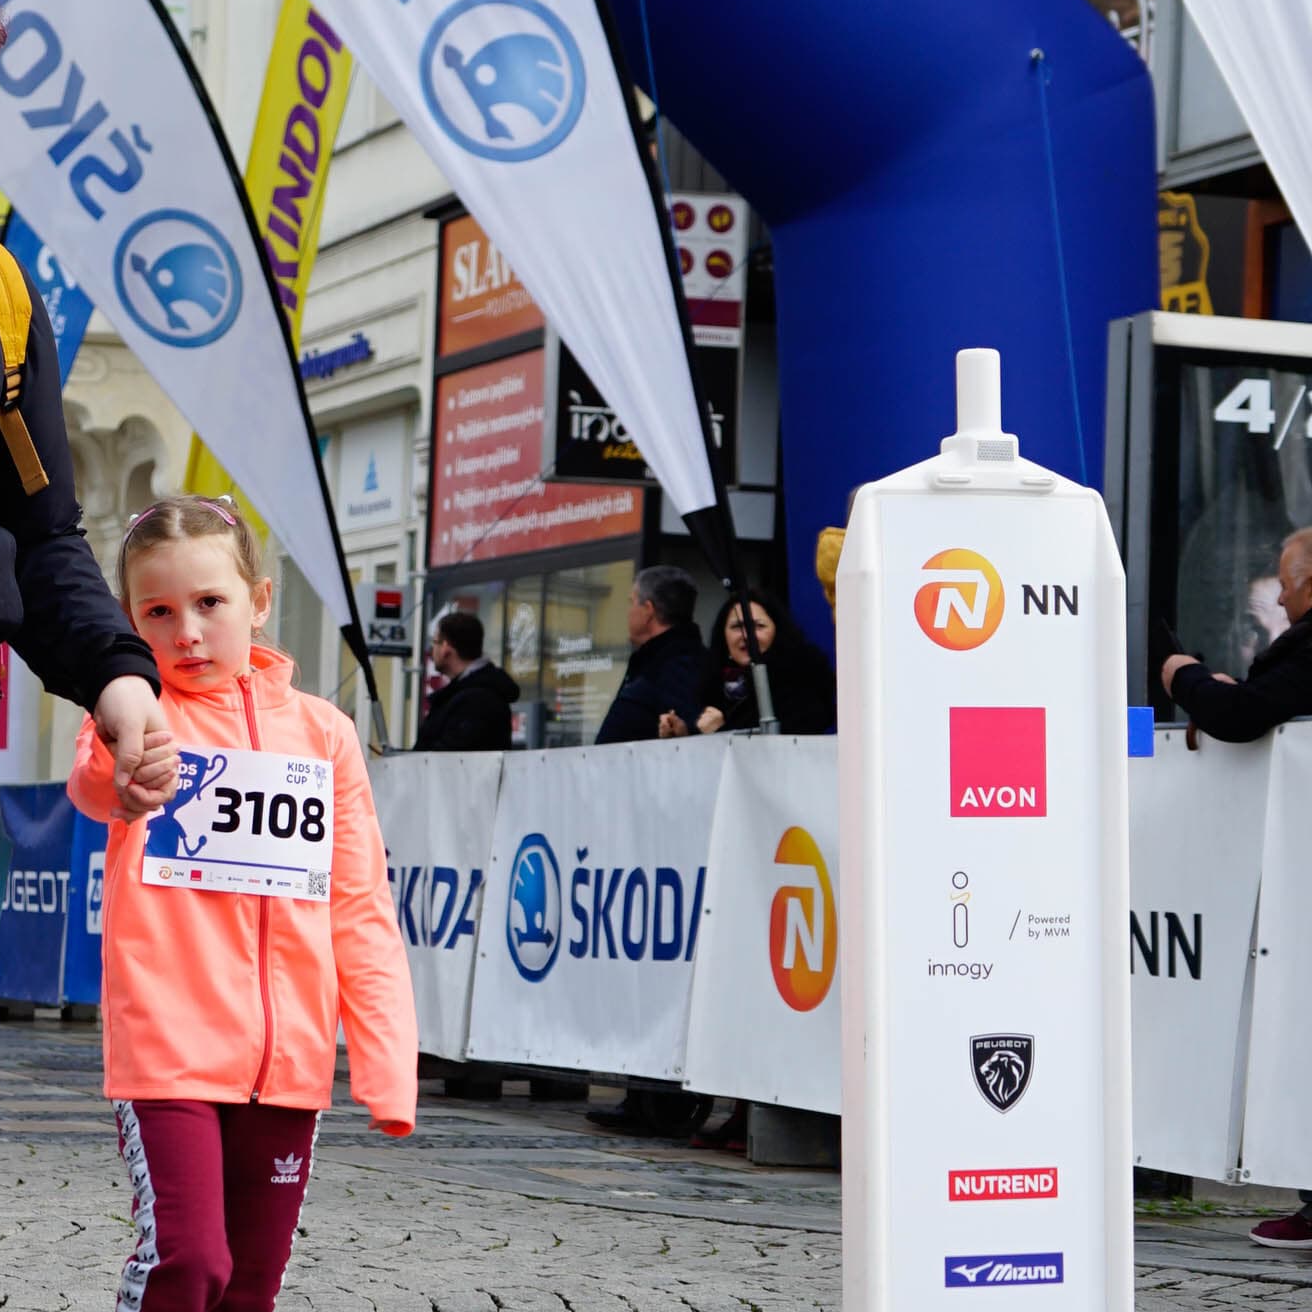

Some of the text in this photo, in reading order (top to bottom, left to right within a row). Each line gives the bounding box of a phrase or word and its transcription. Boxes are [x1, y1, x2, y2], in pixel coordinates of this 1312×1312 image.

[1021, 584, 1079, 616] NN
[288, 762, 311, 774] KIDS
[286, 774, 308, 785] CUP
[960, 787, 1037, 809] AVON
[211, 787, 326, 843] 3108
[1028, 914, 1071, 925] Powered
[1028, 927, 1071, 939] by MVM
[928, 958, 994, 980] innogy
[976, 1040, 1029, 1050] PEUGEOT
[271, 1174, 300, 1184] adidas
[954, 1173, 1054, 1196] NUTREND
